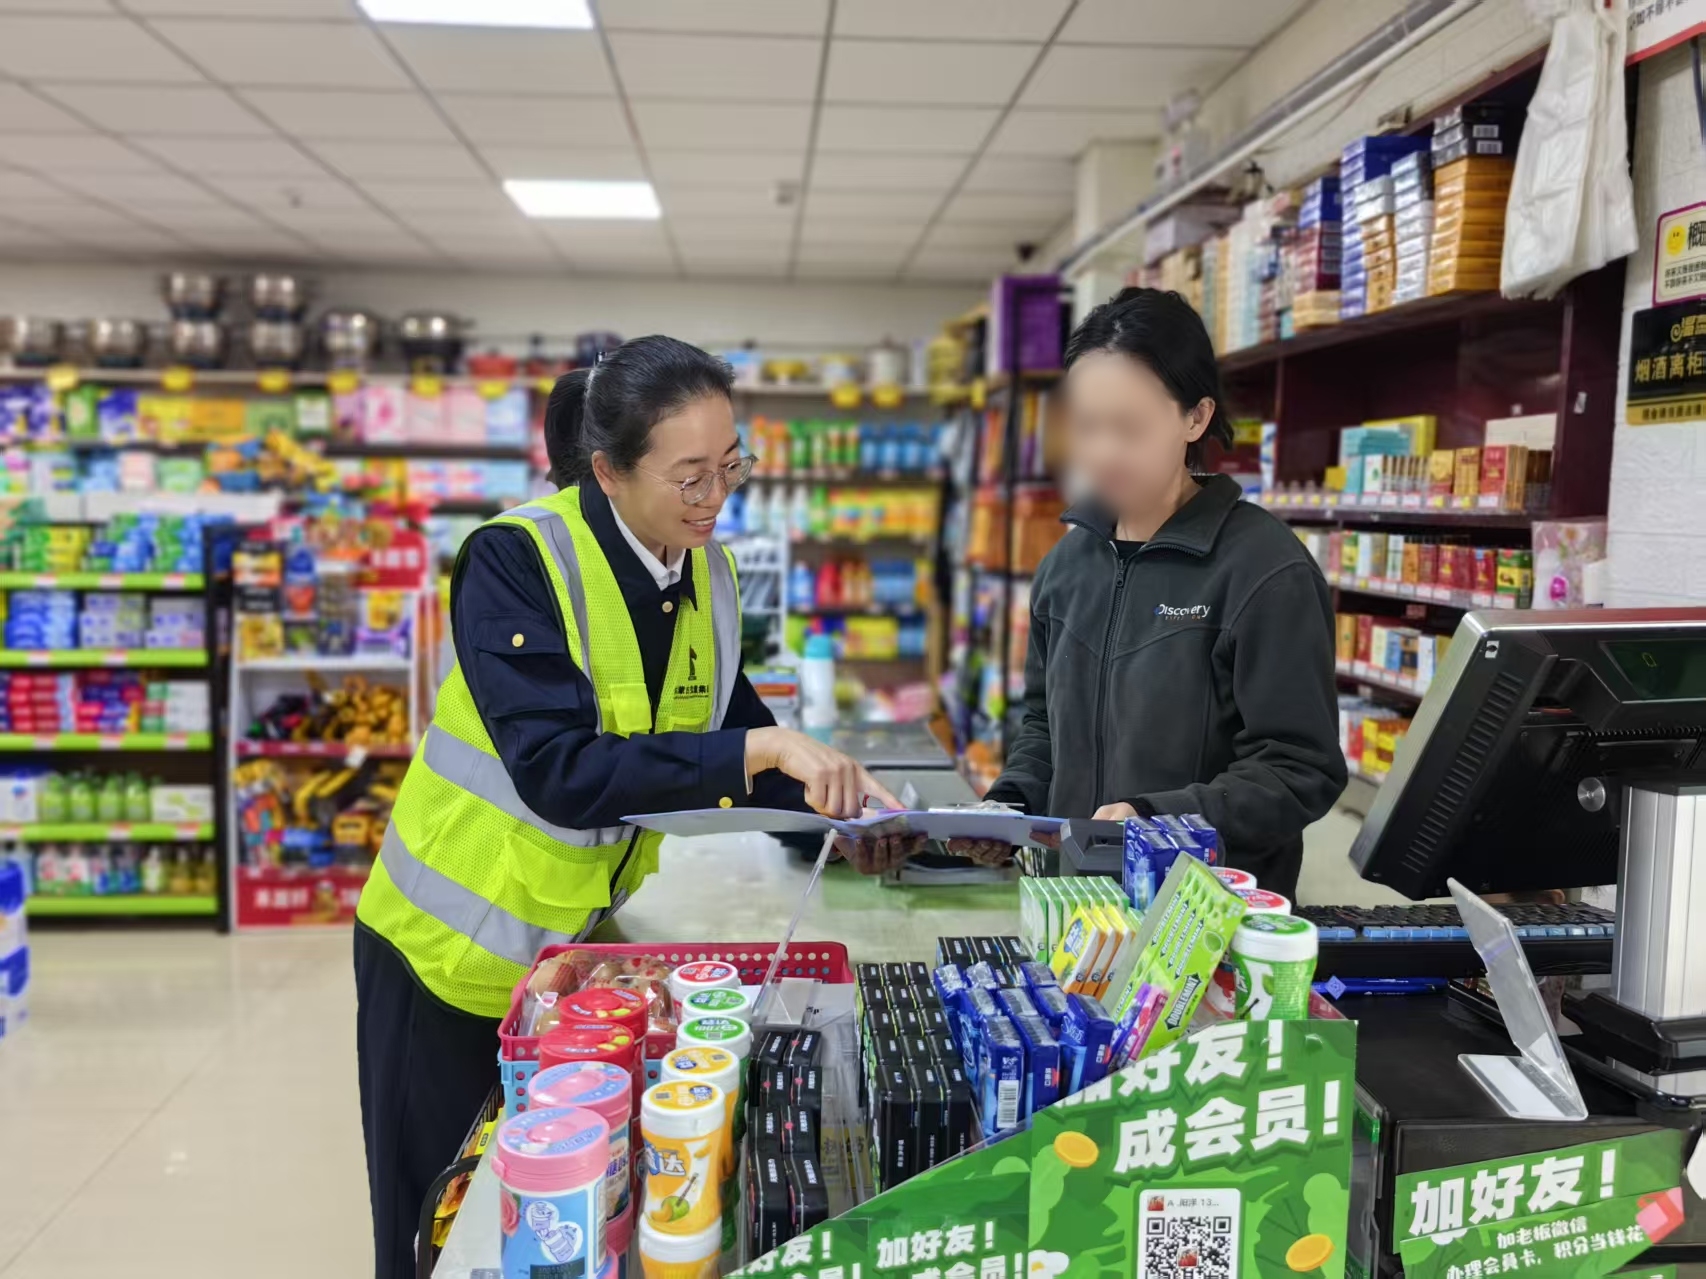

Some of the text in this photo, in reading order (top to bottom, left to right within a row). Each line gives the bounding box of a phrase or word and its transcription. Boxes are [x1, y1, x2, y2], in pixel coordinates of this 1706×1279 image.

[1158, 603, 1211, 617] Discovery
[1167, 975, 1200, 1026] DOUBLEMINT
[1113, 1080, 1341, 1174] 成会员！
[1409, 1149, 1617, 1237] 加好友！
[876, 1220, 994, 1269] 加好友！
[1497, 1216, 1588, 1249] 加老板微信
